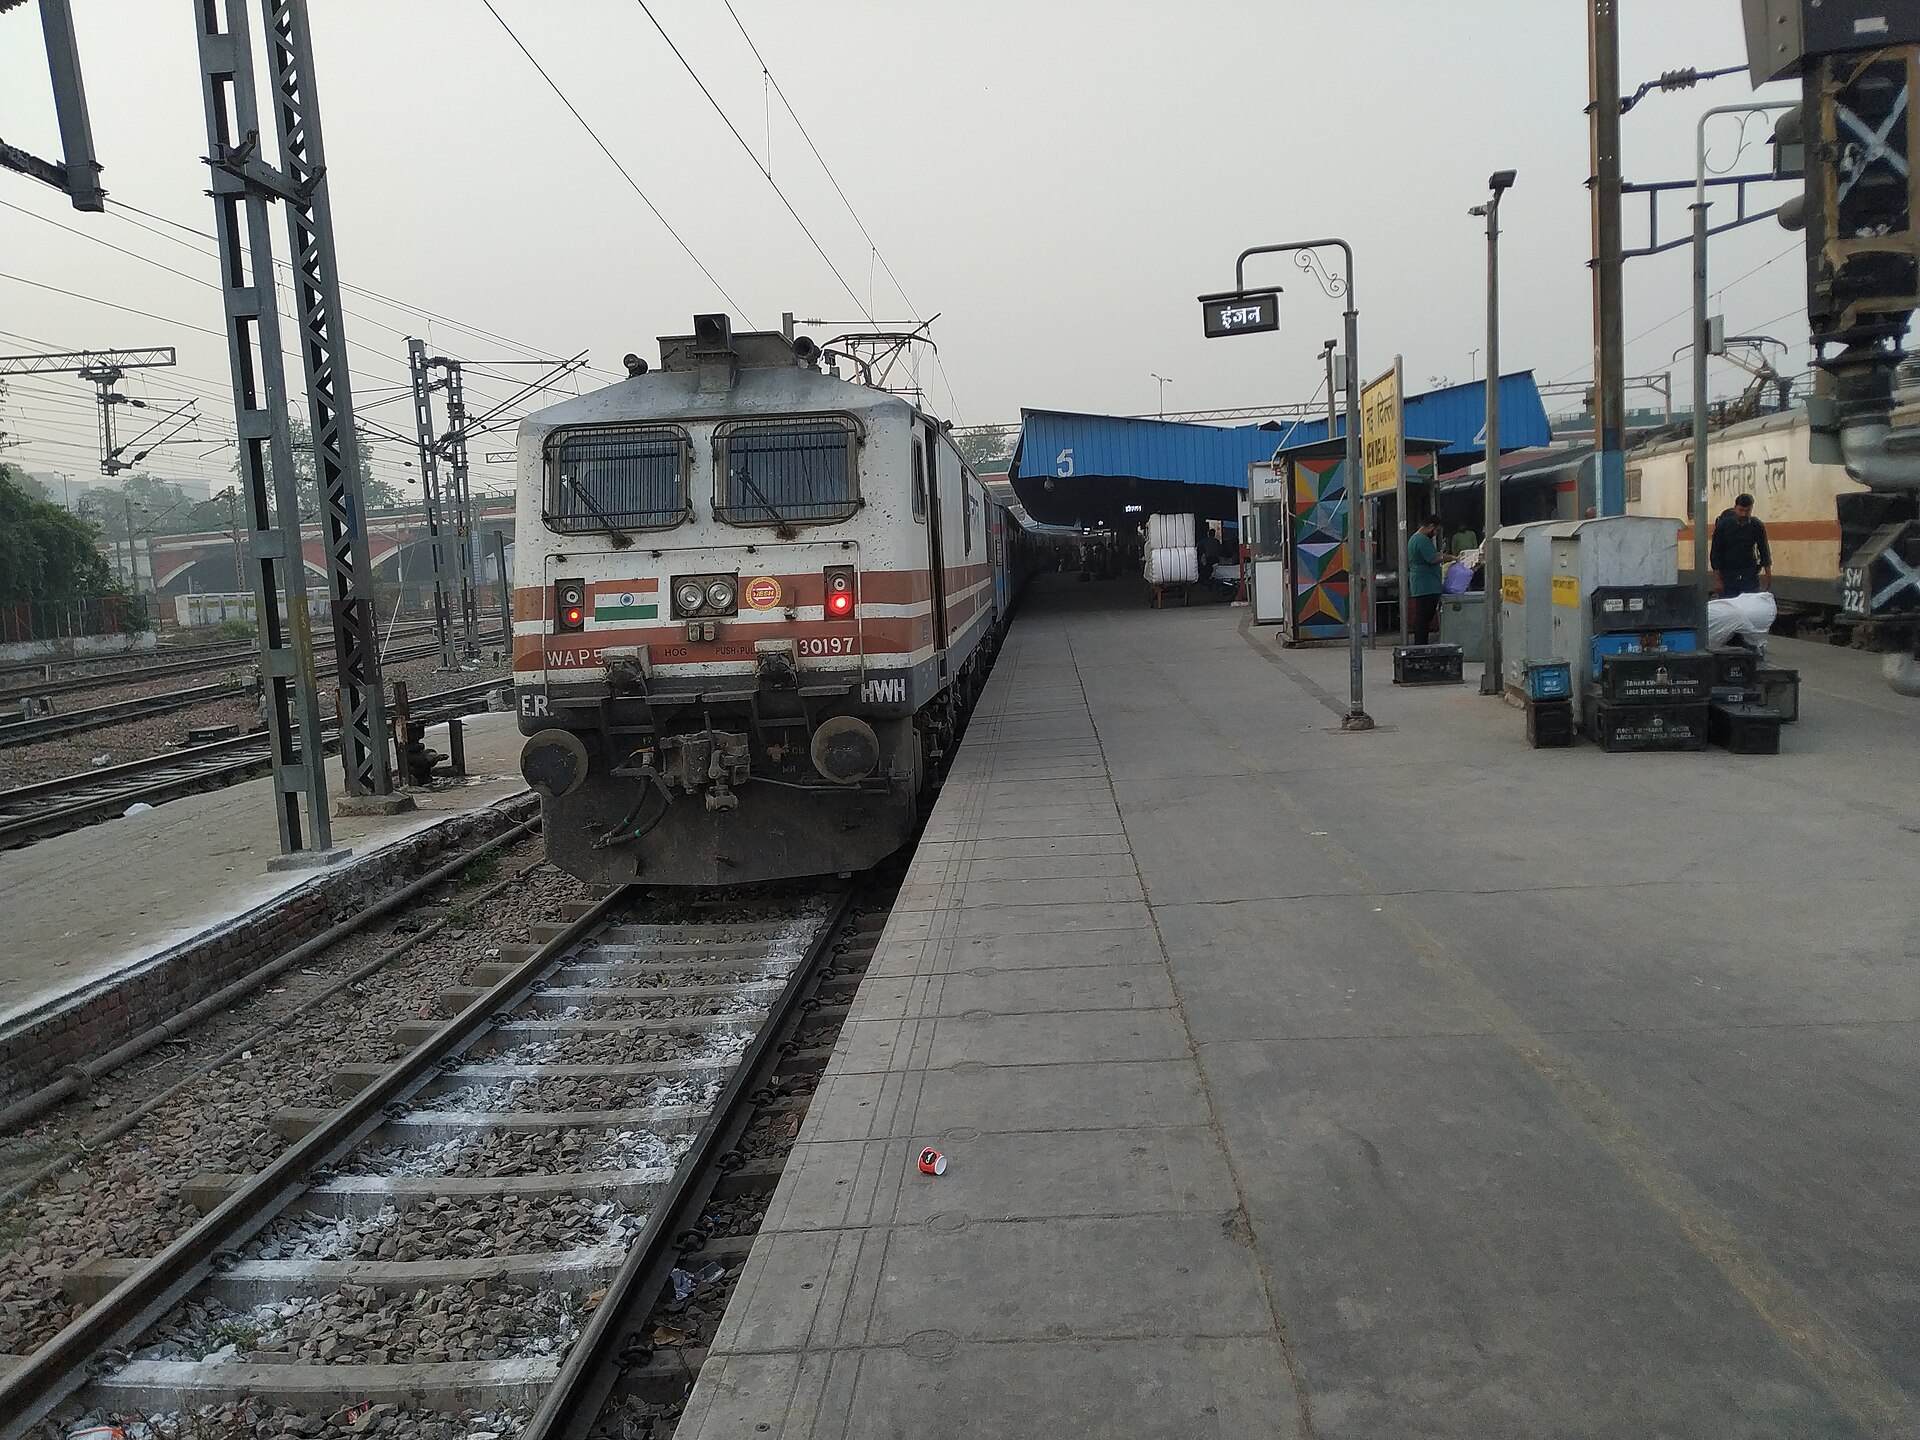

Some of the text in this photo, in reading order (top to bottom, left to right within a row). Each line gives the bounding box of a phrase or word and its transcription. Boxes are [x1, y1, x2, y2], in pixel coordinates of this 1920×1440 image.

[1056, 448, 1074, 478] 5
[1763, 445, 1788, 494] रेल
[1845, 567, 1863, 587] SH
[1844, 590, 1865, 614] 222
[547, 637, 854, 667] WAP5 HOG PUSH-PUL 30197
[861, 678, 906, 703] HWH
[521, 694, 555, 717] E.R.
